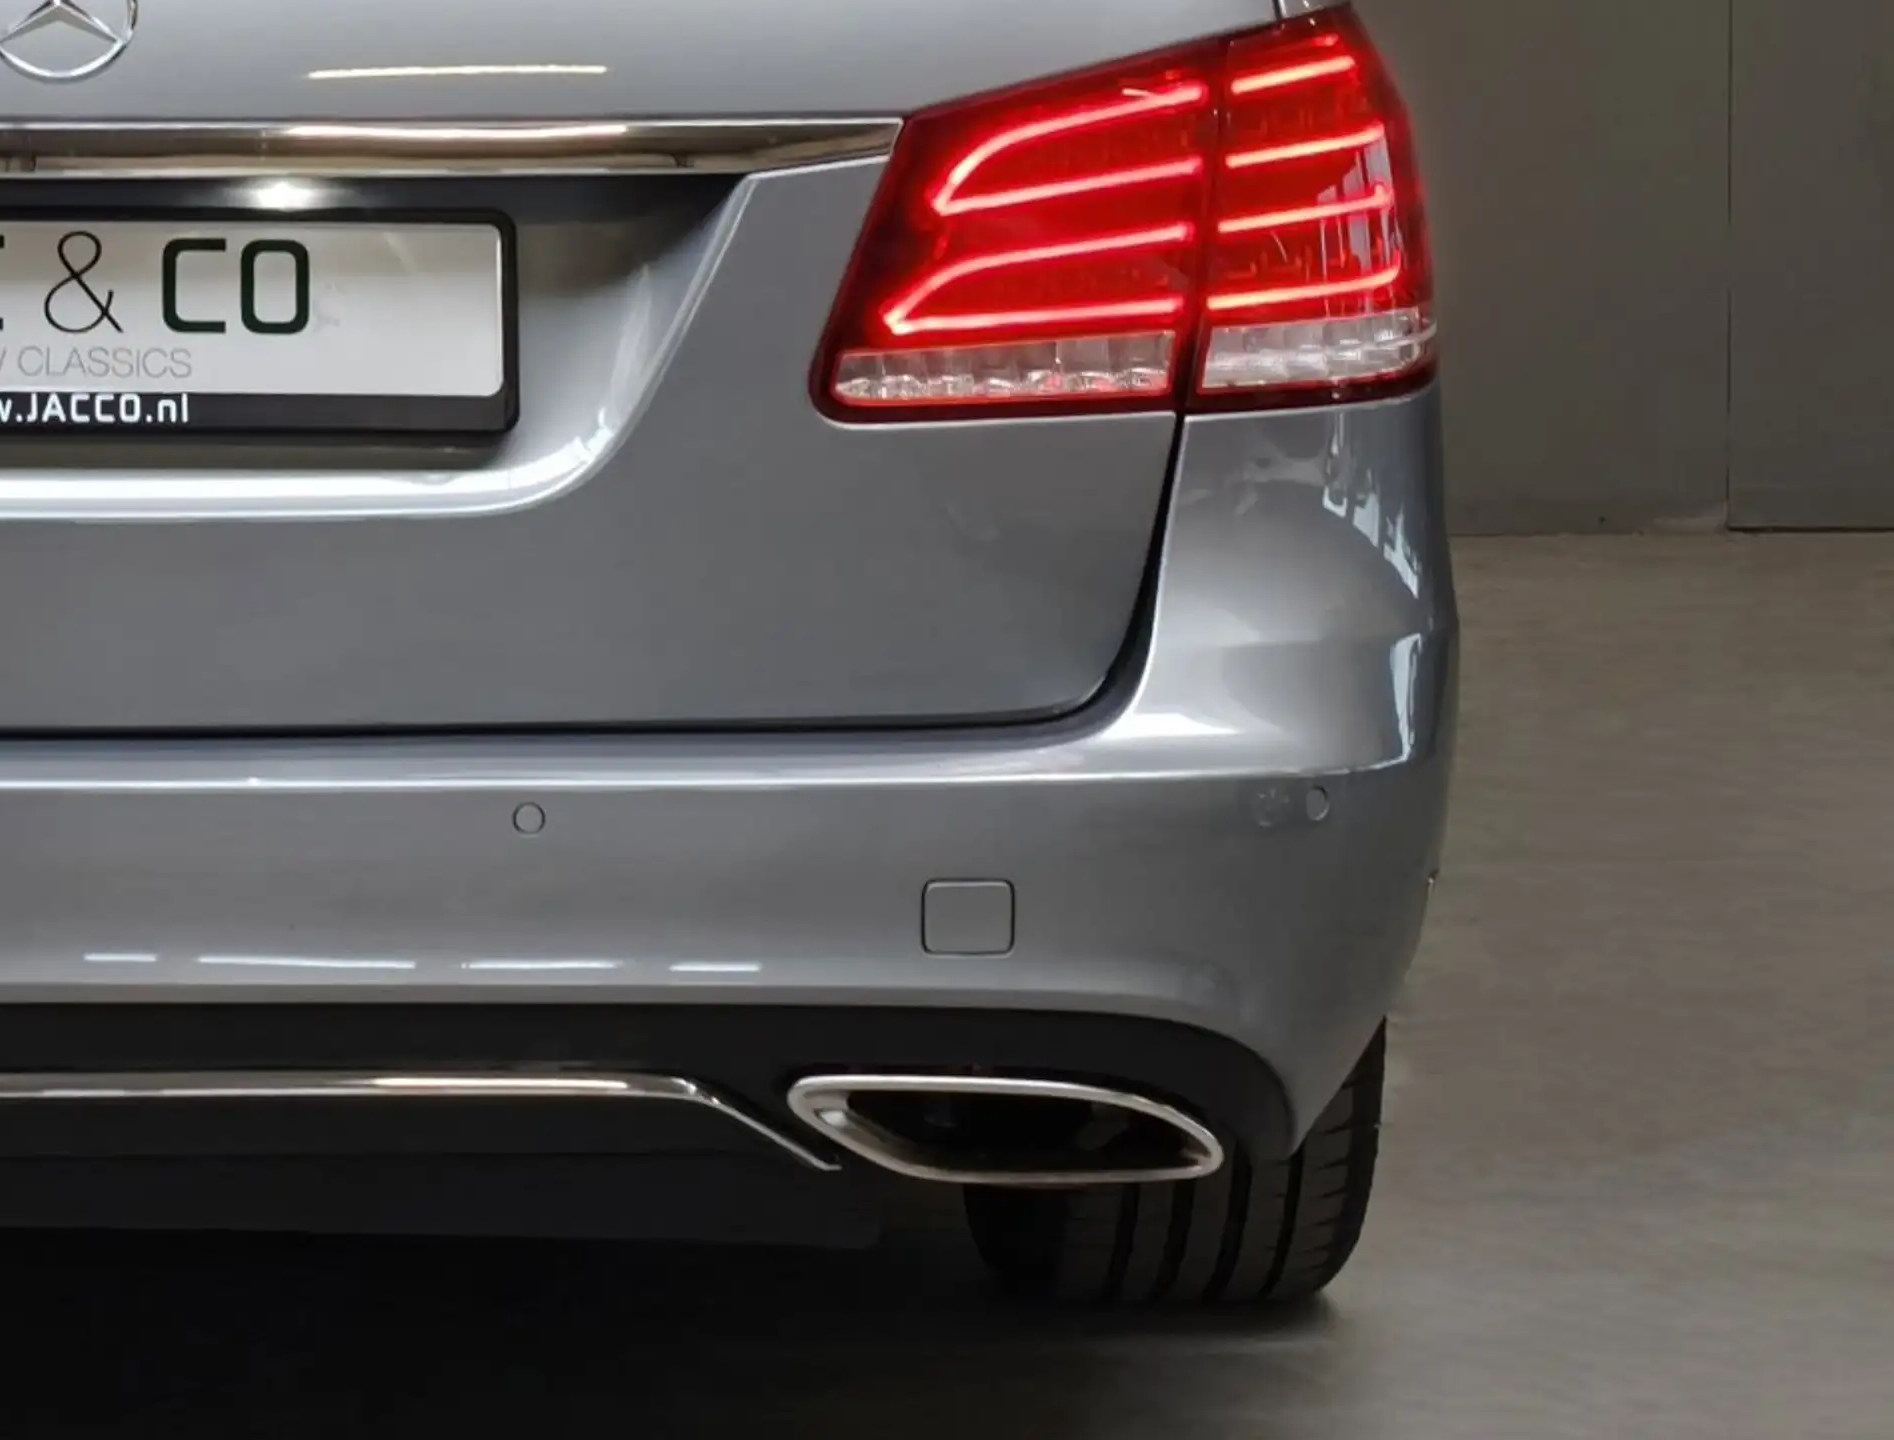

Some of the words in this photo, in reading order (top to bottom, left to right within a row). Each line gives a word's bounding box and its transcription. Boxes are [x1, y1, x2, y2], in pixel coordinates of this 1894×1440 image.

[44, 230, 123, 333] &
[162, 238, 311, 335] CO
[17, 346, 192, 378] CLASSICS
